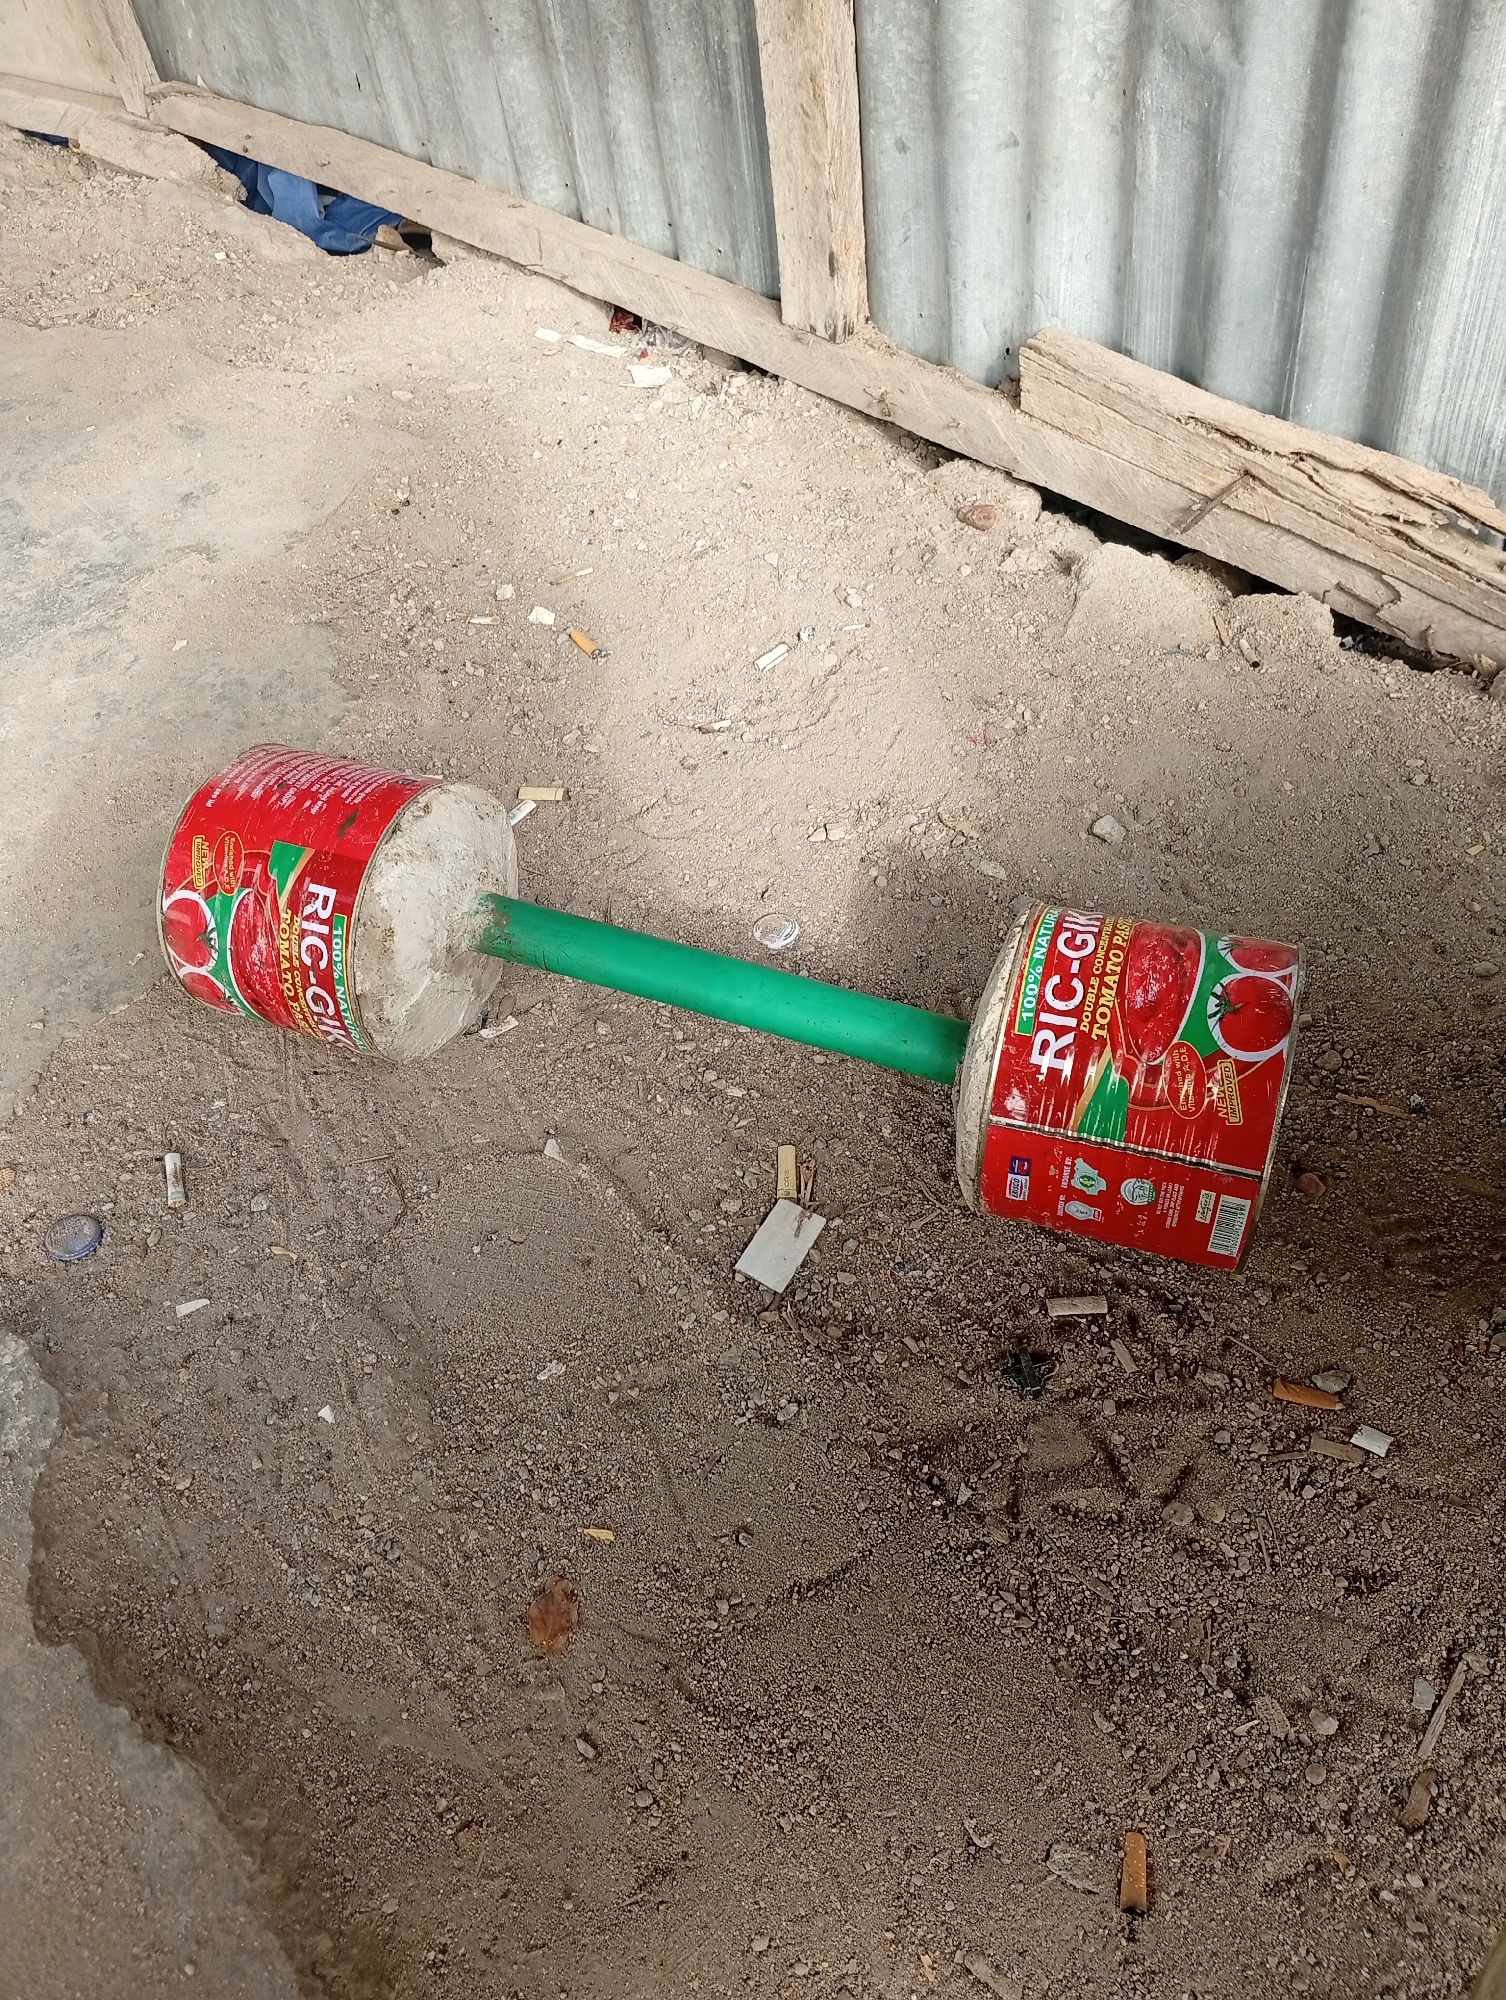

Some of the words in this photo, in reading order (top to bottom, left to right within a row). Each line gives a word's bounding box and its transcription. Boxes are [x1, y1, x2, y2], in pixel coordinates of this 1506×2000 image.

[195, 840, 203, 884] IMPROVED
[202, 841, 210, 869] NEW
[279, 908, 295, 998] TOMATO
[292, 915, 301, 968] DOUBLE
[300, 882, 358, 1050] RIC-GIK
[332, 925, 344, 979] 100%
[1021, 965, 1043, 1022] 100%
[1029, 908, 1104, 1070] RIC-GIK
[1080, 976, 1100, 1034] DOUBLE
[1091, 949, 1125, 1041] TOMATO
[1172, 1050, 1181, 1069] with
[1216, 1081, 1229, 1118] NEW
[1223, 1065, 1238, 1119] IMPROVED
